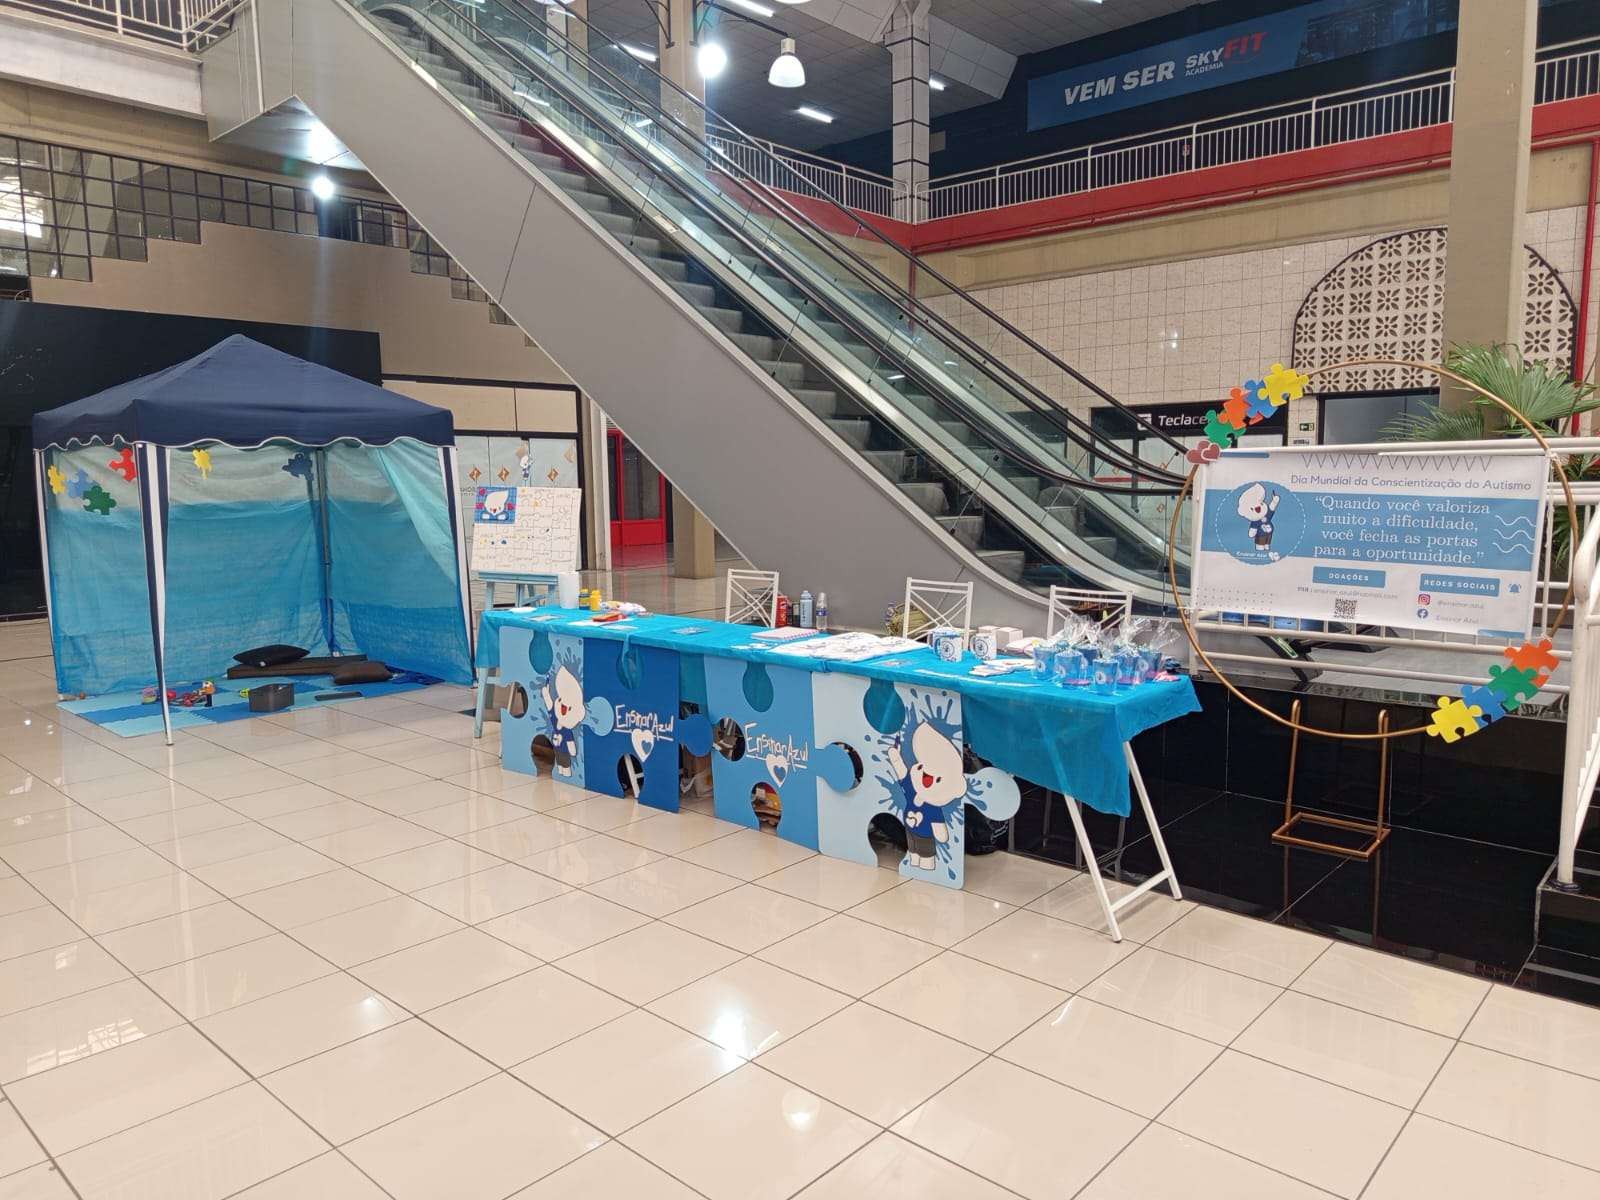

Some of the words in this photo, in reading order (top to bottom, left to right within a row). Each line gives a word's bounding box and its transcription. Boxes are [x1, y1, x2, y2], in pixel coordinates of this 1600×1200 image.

[1184, 62, 1224, 77] ACADEMIA
[1064, 76, 1117, 106] VEM
[1122, 60, 1176, 91] SER
[1158, 413, 1208, 427] Teclace
[1290, 474, 1307, 485] Dia
[1310, 475, 1351, 486] Mundial
[1354, 476, 1368, 486] da
[1371, 477, 1461, 490] Conscientização
[1464, 479, 1480, 489] do
[1482, 479, 1532, 491] Autismo
[1386, 499, 1421, 512] você
[1427, 500, 1490, 514] valoriza
[1322, 512, 1366, 525] muito
[1371, 517, 1381, 527] a
[1386, 513, 1479, 532] dificuldade,
[1321, 528, 1354, 541] você
[1359, 529, 1399, 543] fecha
[1404, 534, 1421, 545] as
[1427, 535, 1478, 548] portas
[1313, 545, 1346, 558] para
[1352, 549, 1361, 558] a
[1423, 578, 1454, 588] REDES
[1456, 581, 1496, 592] SOCIAIS
